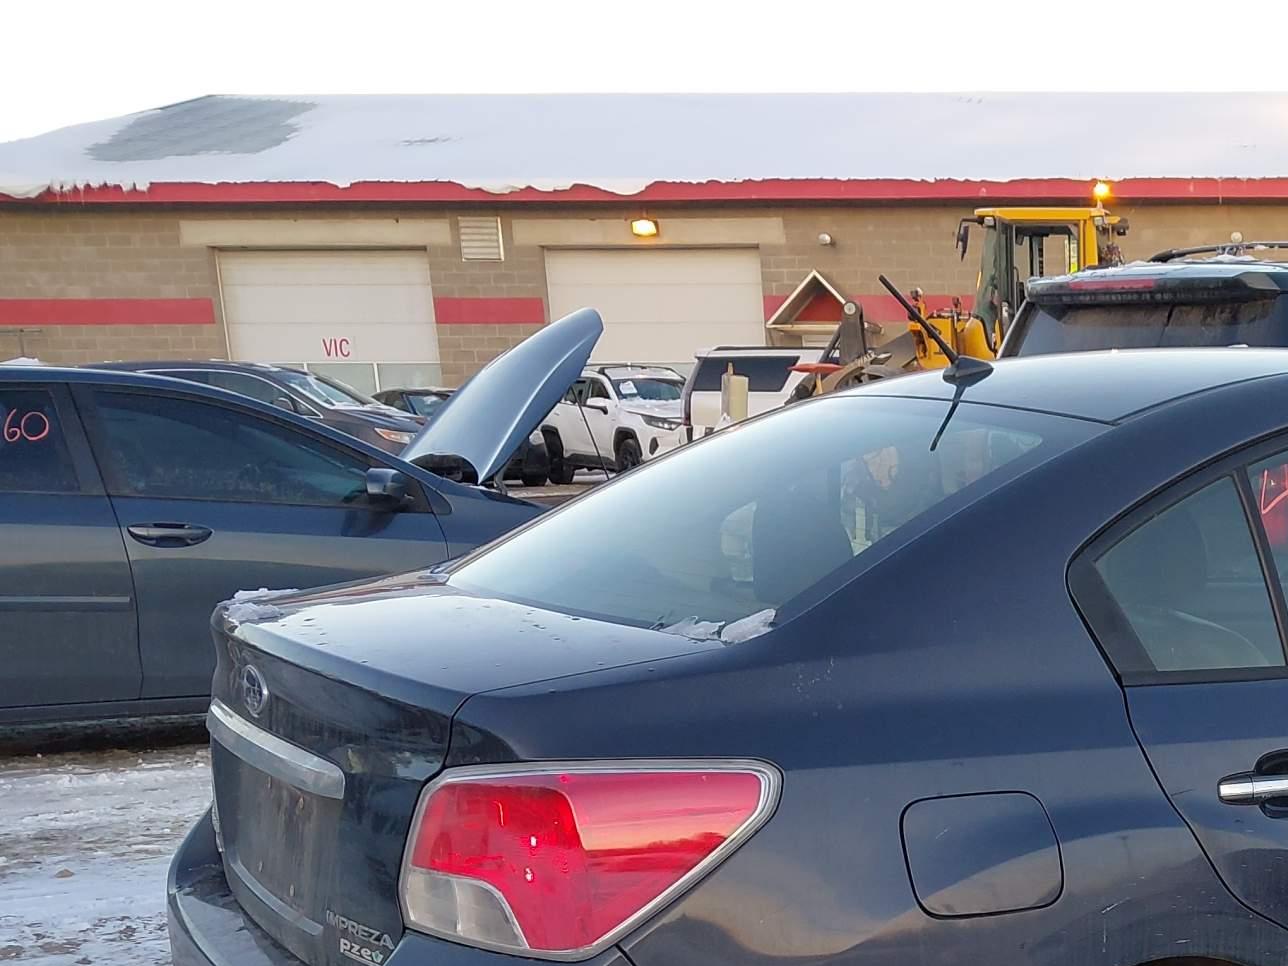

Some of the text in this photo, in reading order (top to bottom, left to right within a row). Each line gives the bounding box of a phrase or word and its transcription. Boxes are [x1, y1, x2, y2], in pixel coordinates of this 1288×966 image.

[322, 338, 351, 358] VIC
[3, 408, 49, 442] 60
[326, 910, 395, 950] IMPREZA
